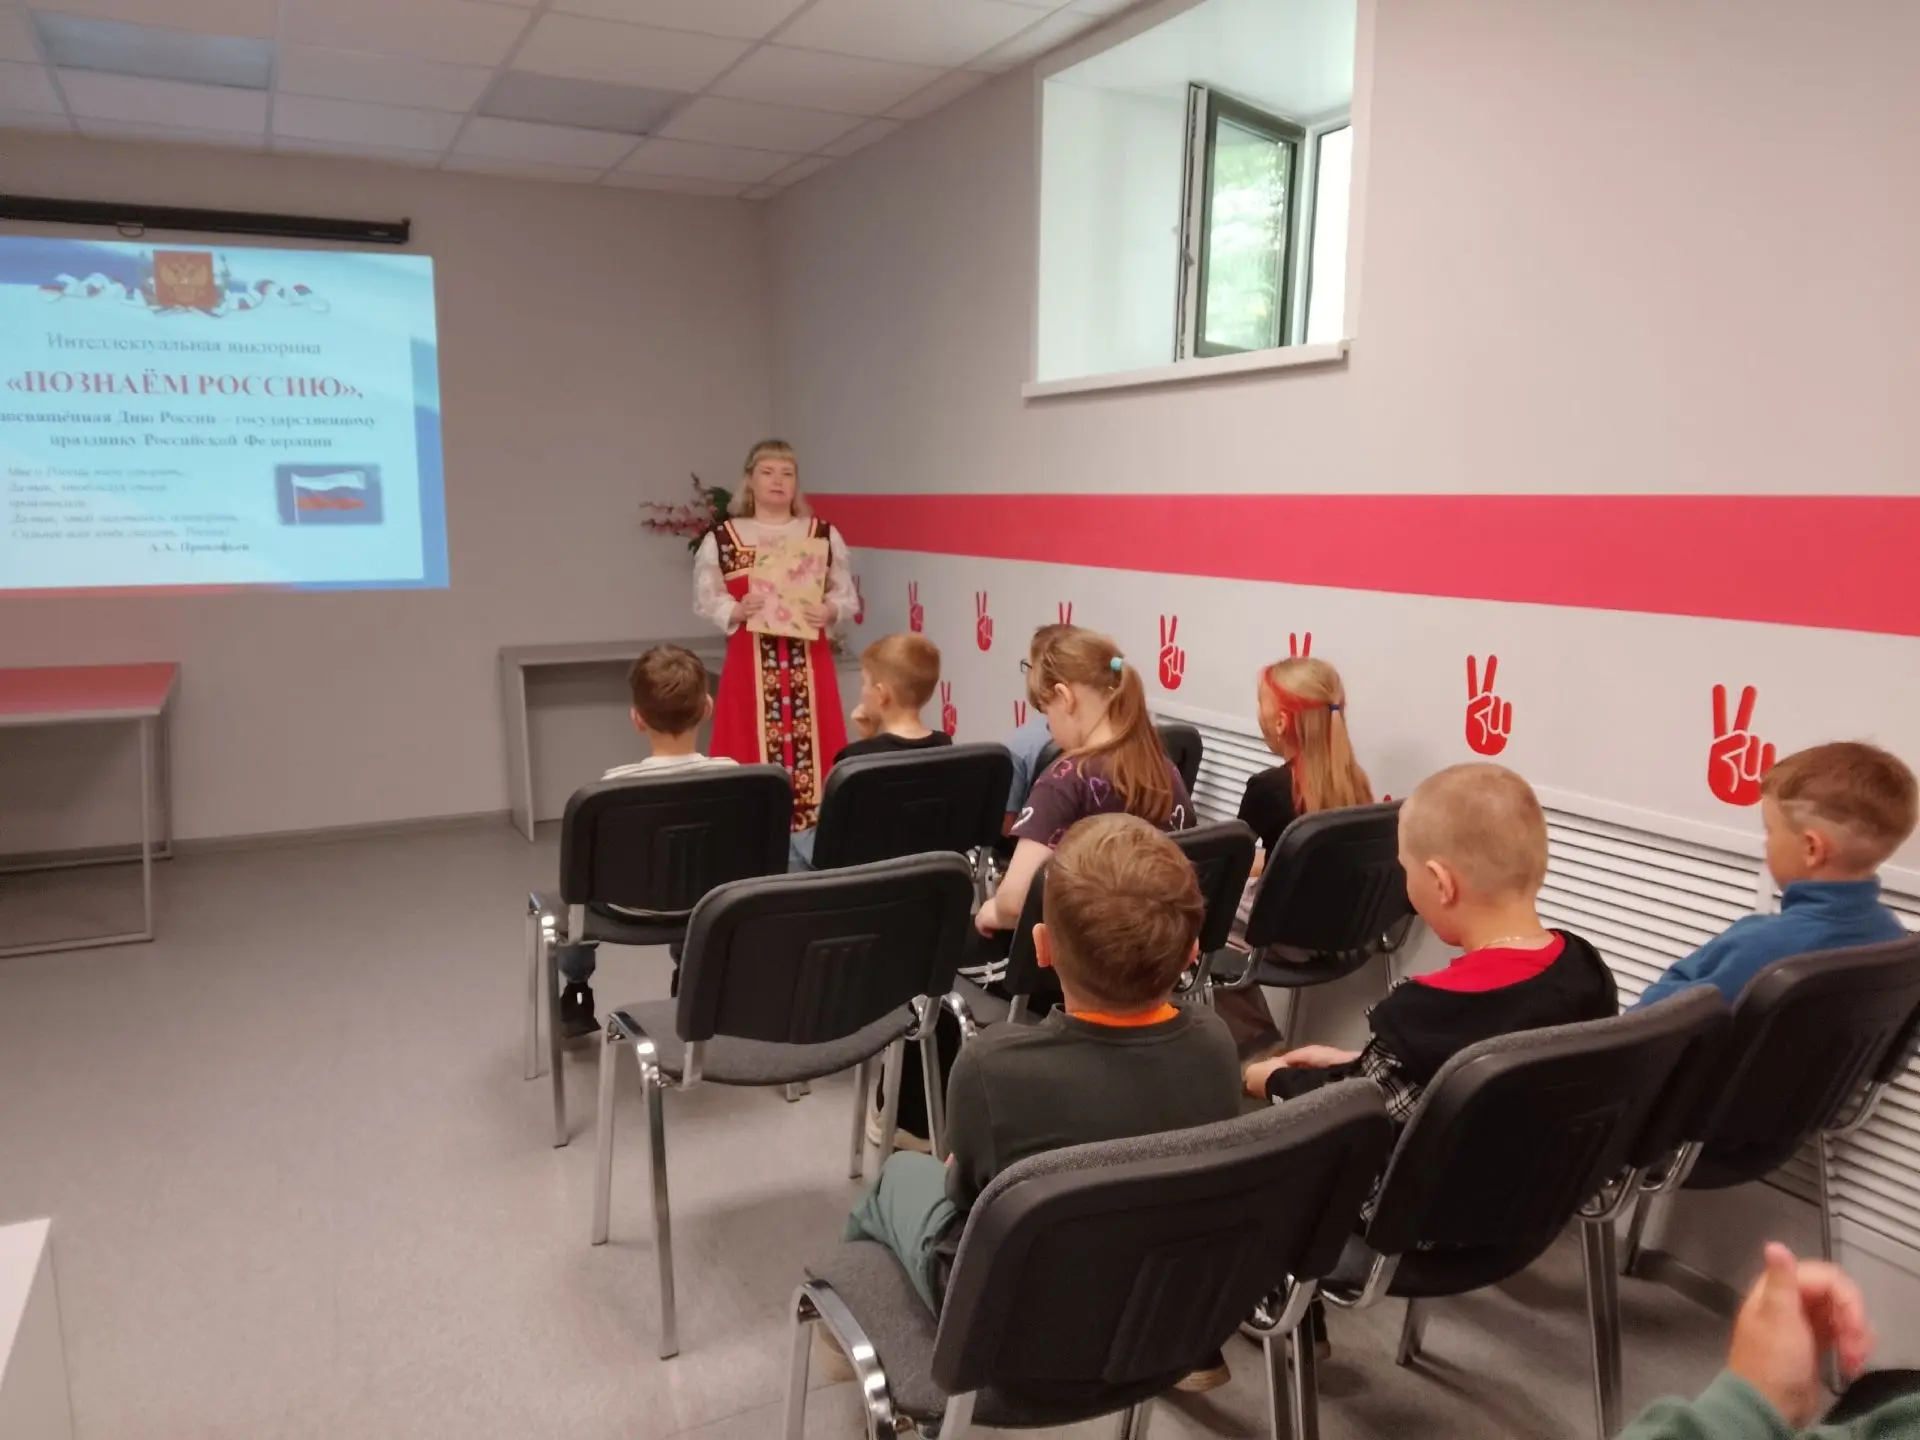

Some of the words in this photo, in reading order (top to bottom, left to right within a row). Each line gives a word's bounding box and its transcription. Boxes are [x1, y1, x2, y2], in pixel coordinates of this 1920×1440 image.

[47, 331, 221, 353] Интеллектуальная
[228, 341, 321, 357] викторина
[6, 368, 189, 395] «ПОЗНАЁМ
[197, 373, 364, 399] РОССИЮ»,
[118, 410, 154, 425] Дню
[160, 411, 216, 426] России
[143, 433, 237, 448] Российской
[244, 434, 332, 449] Федерации
